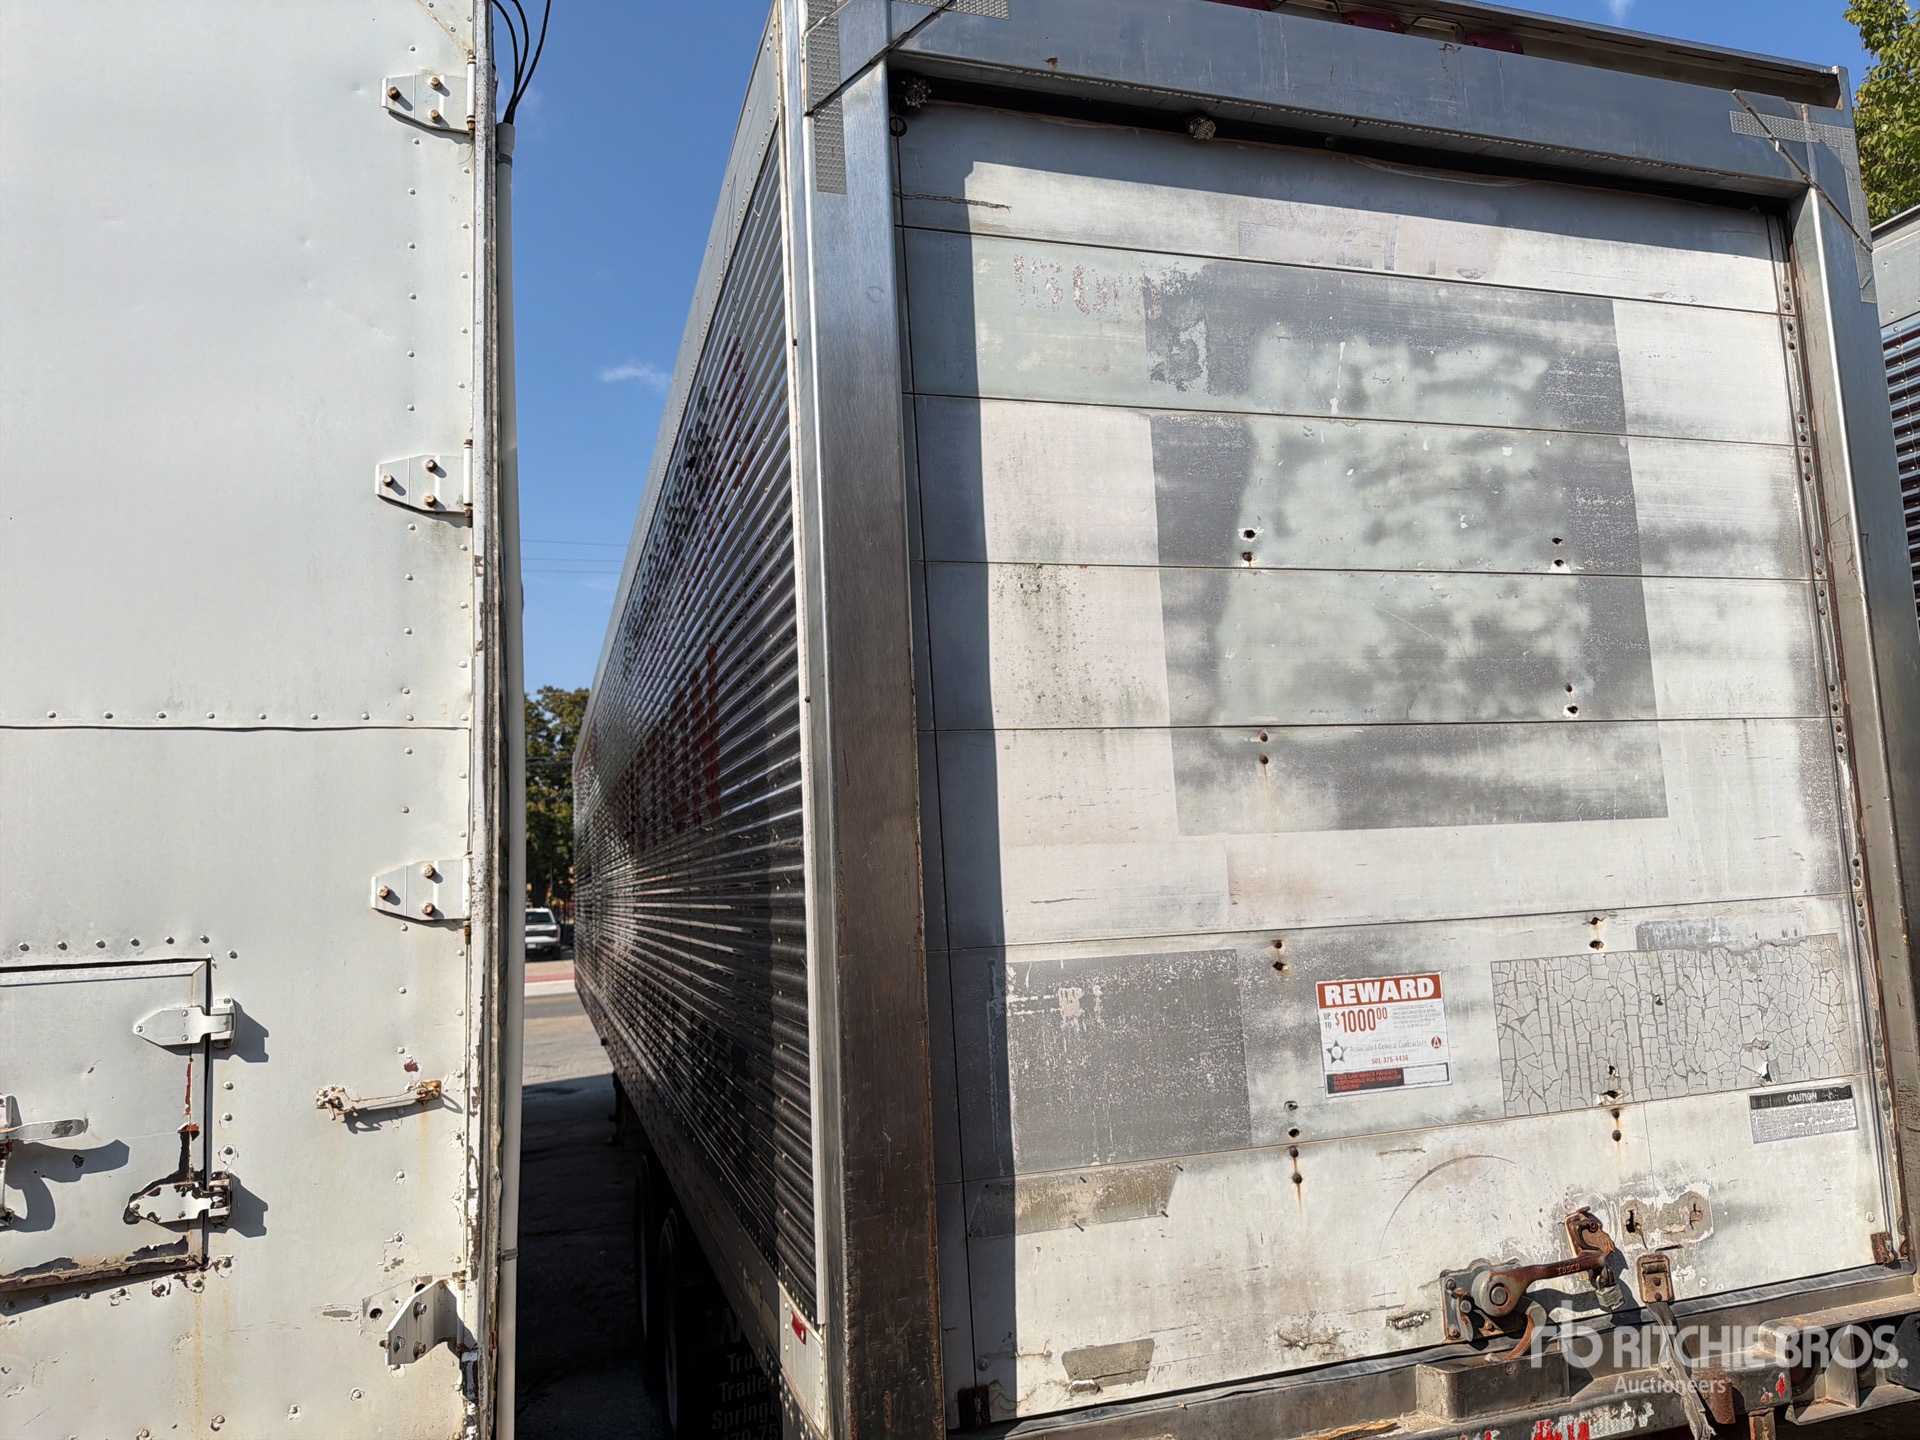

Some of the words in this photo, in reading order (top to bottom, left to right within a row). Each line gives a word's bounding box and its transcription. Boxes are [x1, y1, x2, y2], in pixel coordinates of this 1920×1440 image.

[1325, 978, 1434, 1006] REWARD
[1323, 1012, 1331, 1020] UP
[1324, 1022, 1332, 1030] TO
[1378, 1042, 1398, 1050] General
[1398, 1039, 1427, 1049] Contractors
[1787, 1092, 1818, 1103] CAUTION
